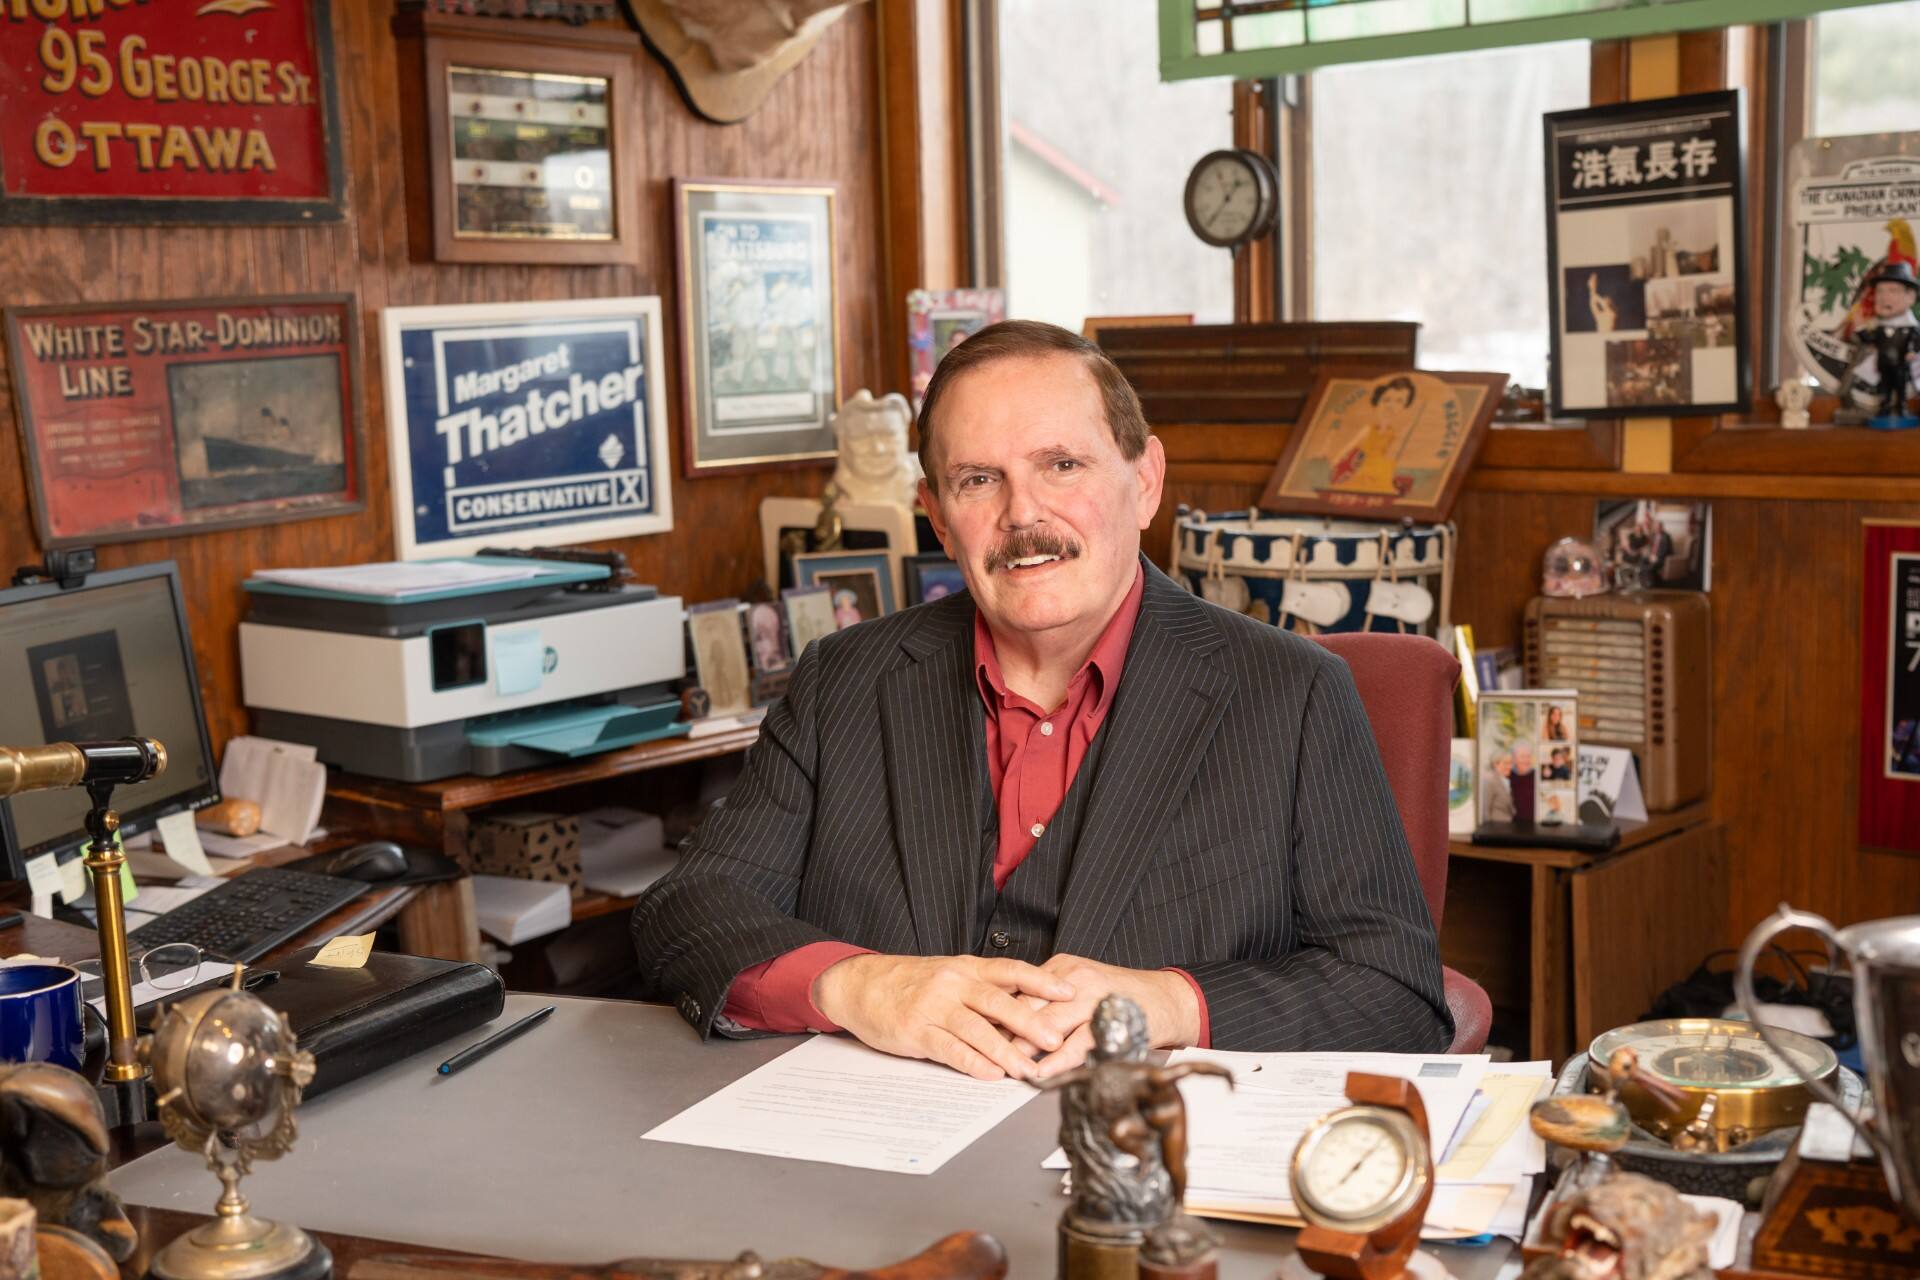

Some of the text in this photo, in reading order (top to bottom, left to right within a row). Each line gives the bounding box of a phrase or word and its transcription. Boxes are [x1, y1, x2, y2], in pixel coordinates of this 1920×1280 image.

[40, 27, 113, 96] 95
[35, 118, 277, 170] OTTAWA
[1572, 137, 1717, 189] 浩氣長存
[25, 322, 127, 358] WHITE
[59, 363, 132, 399] LINE
[454, 342, 571, 404] Margaret
[435, 364, 644, 466] Thatcher
[456, 482, 612, 521] CONSERVATIVE
